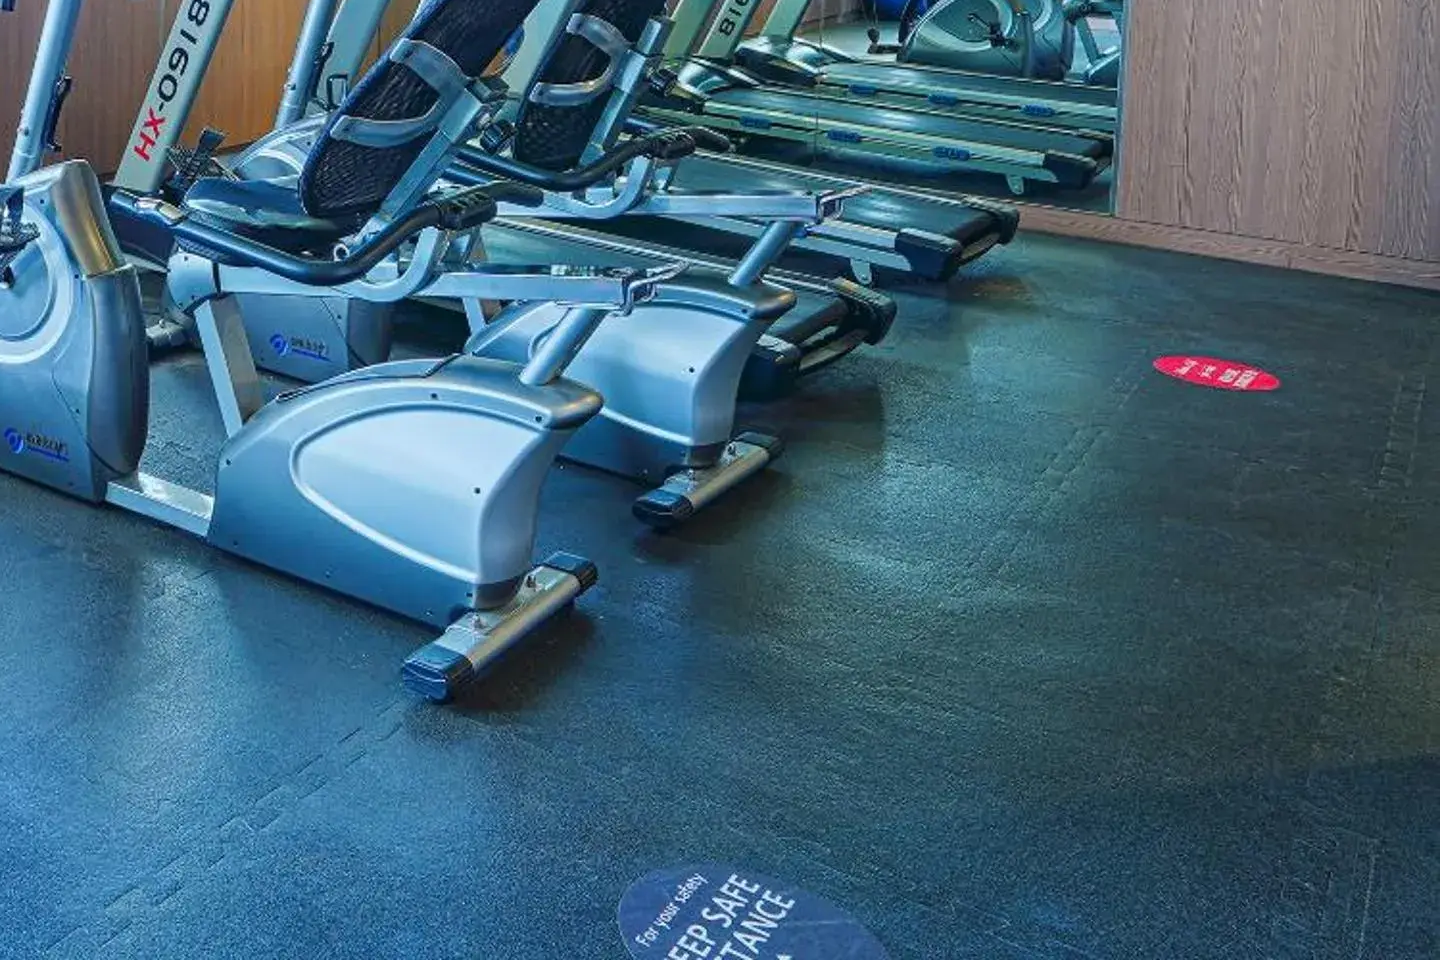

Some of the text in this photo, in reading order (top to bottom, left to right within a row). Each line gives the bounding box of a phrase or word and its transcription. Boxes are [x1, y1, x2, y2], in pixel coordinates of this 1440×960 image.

[635, 872, 709, 948] For your safety
[664, 873, 761, 960] EEP SAFE
[713, 889, 796, 960] TANCE
